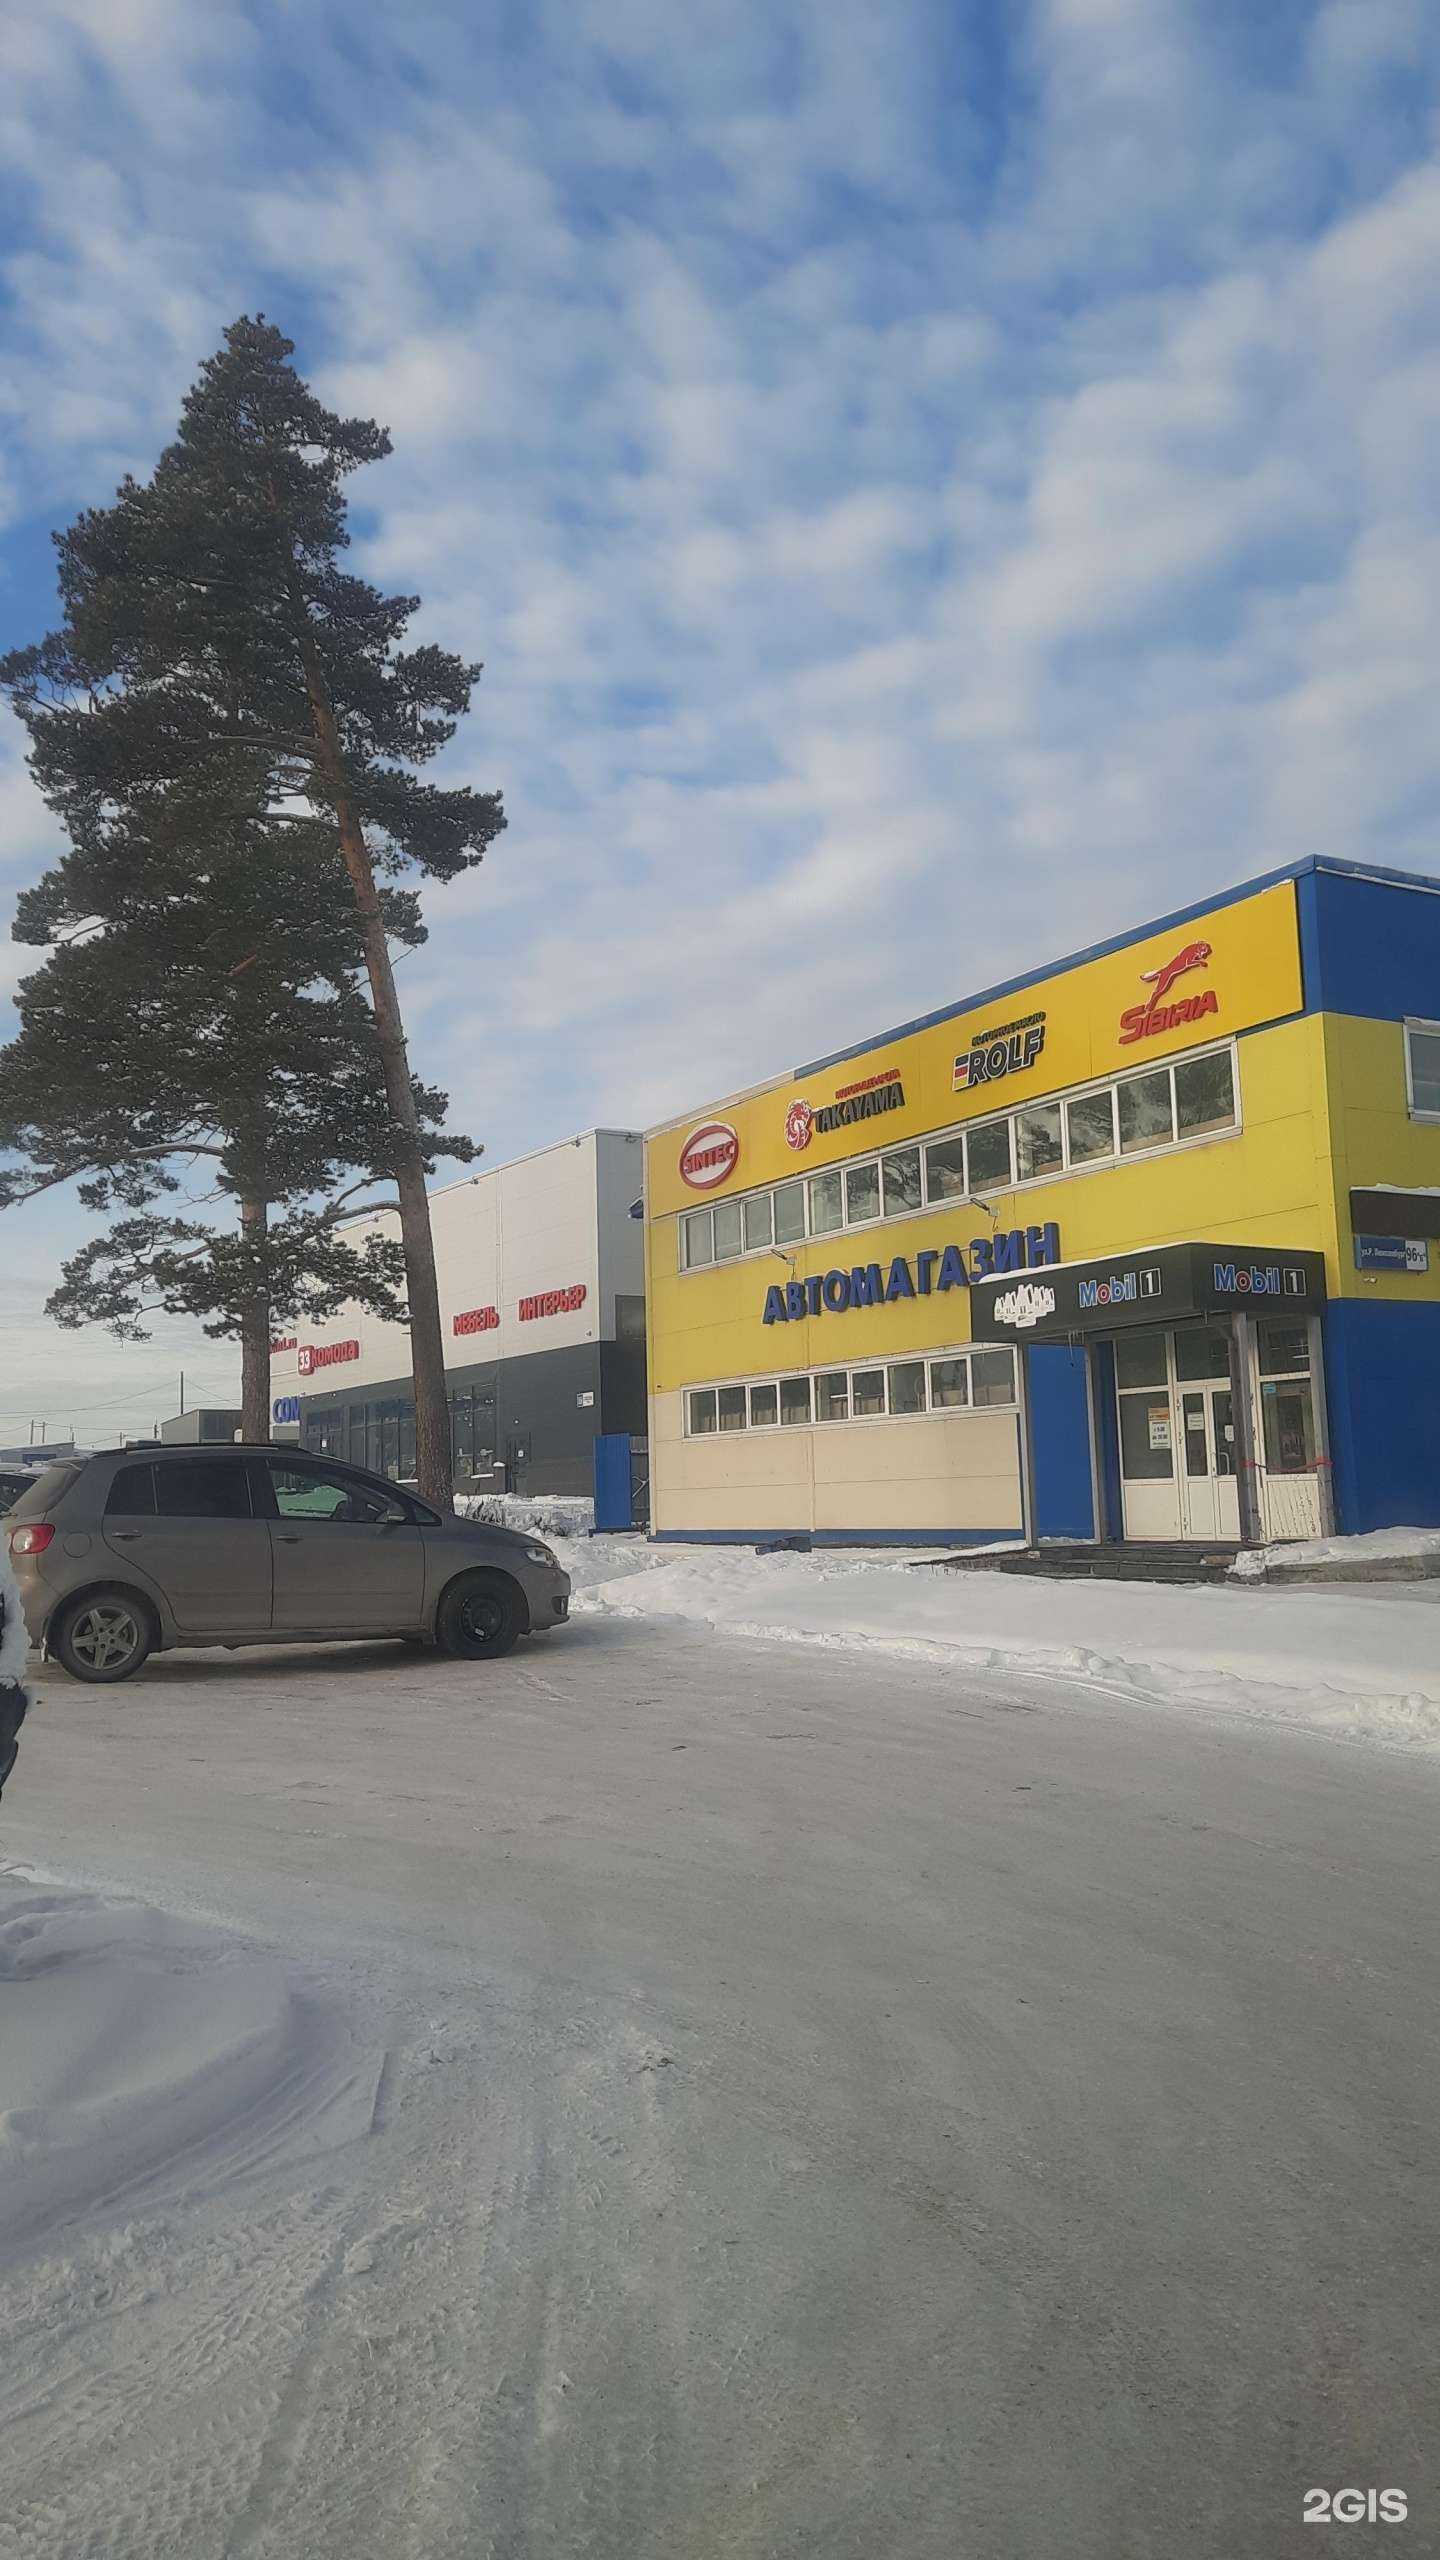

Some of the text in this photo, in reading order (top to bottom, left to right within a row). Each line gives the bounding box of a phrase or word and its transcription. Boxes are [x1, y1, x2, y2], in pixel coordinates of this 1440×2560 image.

[1119, 990, 1218, 1045] SIBIRIA
[967, 1025, 1045, 1086] ROLF
[814, 1082, 905, 1133] TAKAYAMA
[684, 1140, 735, 1174] SINTEC
[762, 1222, 1060, 1325] АВТОМАГАЗИН
[1079, 1271, 1137, 1308] Mobil
[1213, 1263, 1281, 1294] Mobil
[453, 1284, 586, 1336] МЕБЕЛЬ ИНТЕРЬЕР
[299, 1350, 311, 1370] 33
